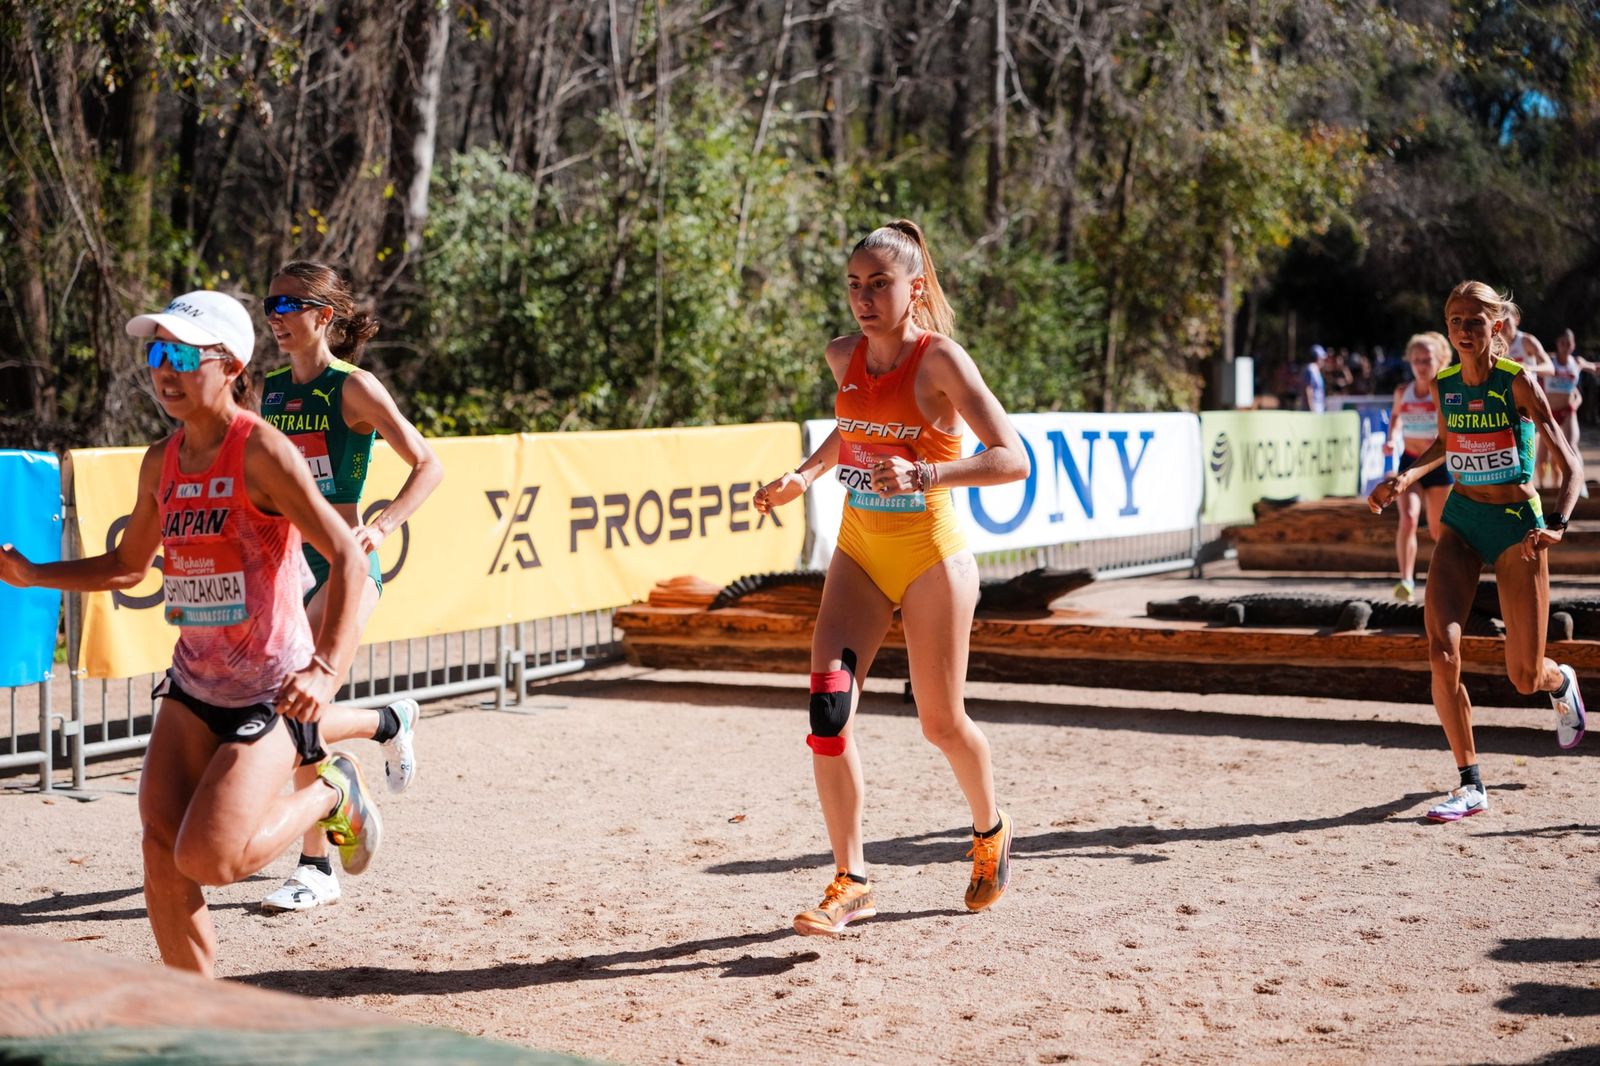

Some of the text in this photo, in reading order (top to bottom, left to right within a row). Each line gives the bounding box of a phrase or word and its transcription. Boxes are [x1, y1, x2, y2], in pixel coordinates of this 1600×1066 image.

[167, 302, 204, 317] APAN
[836, 416, 921, 440] SPAÑA
[1448, 412, 1510, 428] AUSTRALIA
[1240, 440, 1294, 482] WORLD
[1451, 451, 1513, 470] OATES
[839, 468, 872, 490] FOR
[968, 430, 1155, 535] ONY
[854, 493, 907, 508] TALLAHASSEE
[161, 507, 229, 538] JAPAN
